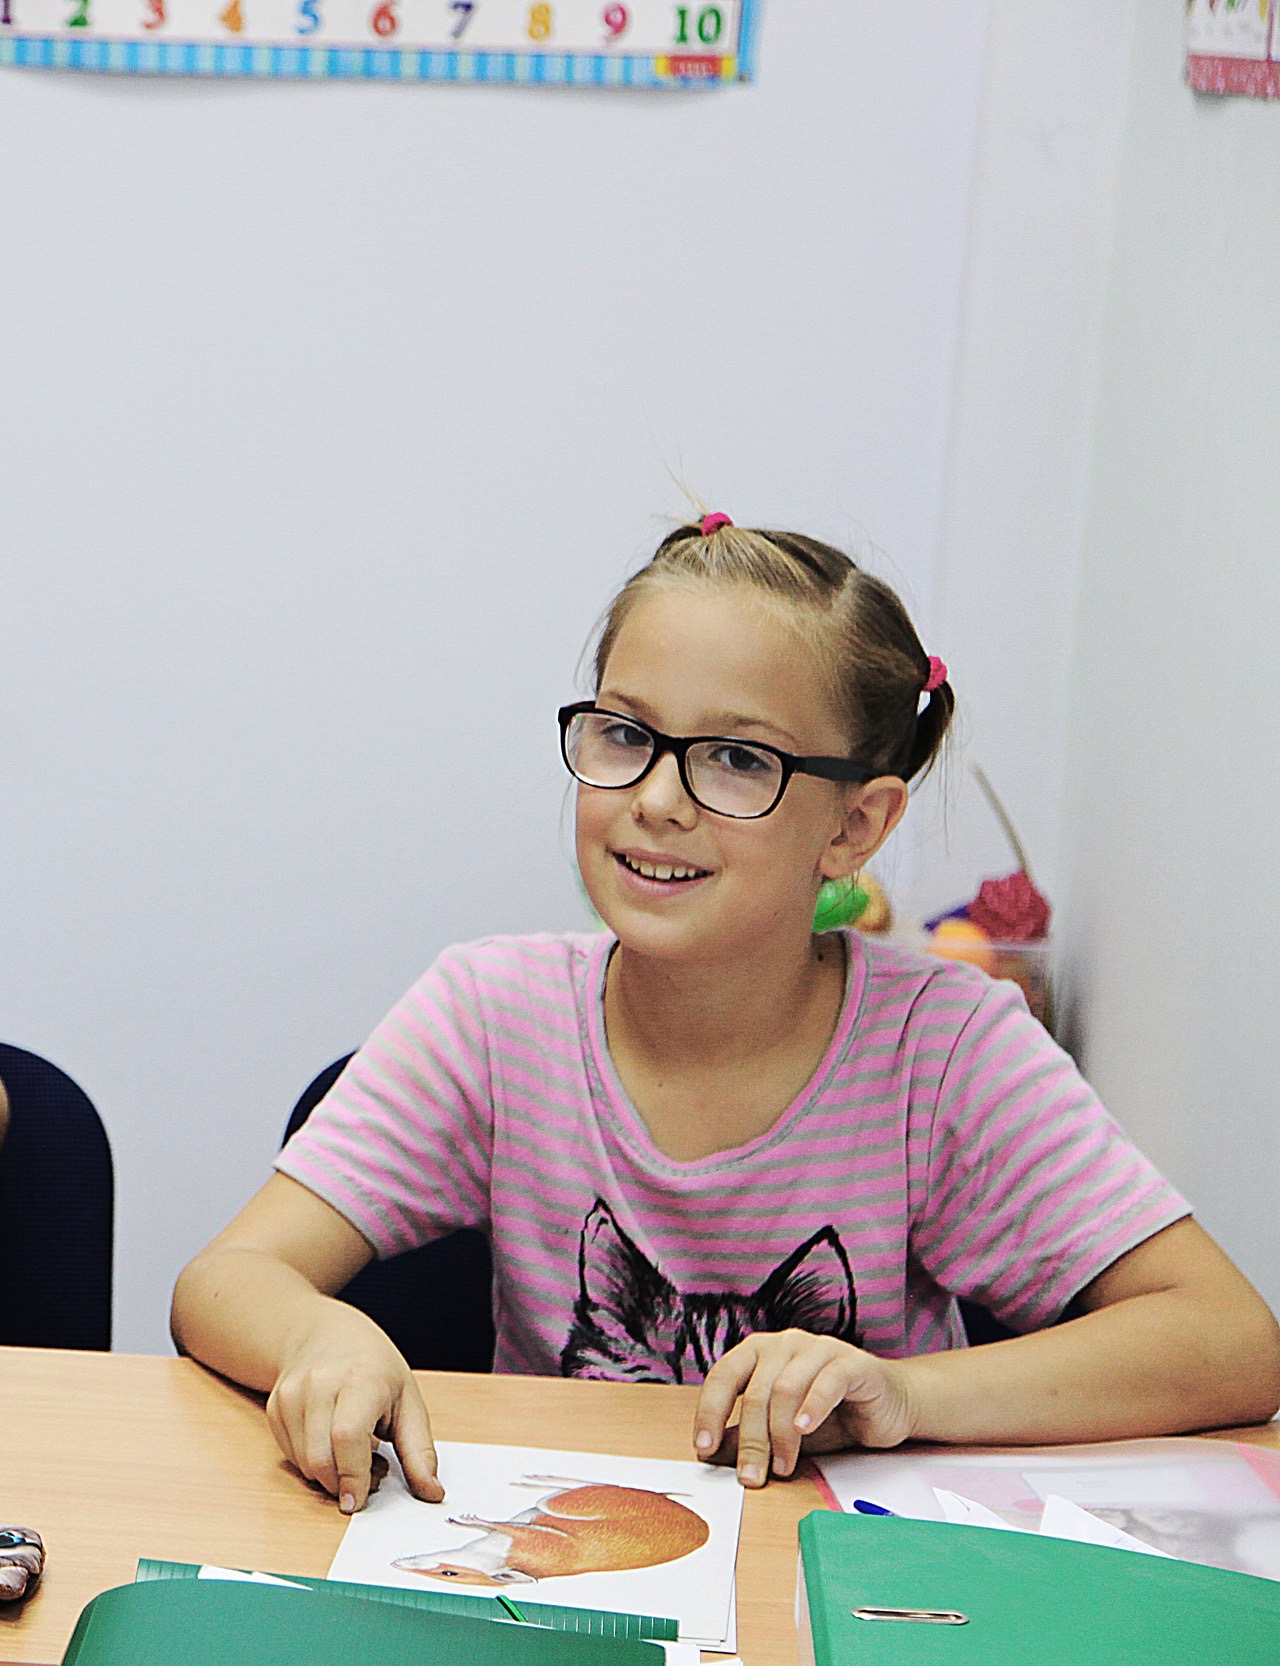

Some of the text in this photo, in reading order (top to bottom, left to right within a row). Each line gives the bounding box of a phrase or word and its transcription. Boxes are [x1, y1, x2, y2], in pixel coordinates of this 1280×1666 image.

[68, 0, 90, 27] 2
[143, 0, 166, 30] 3
[219, 0, 245, 32] 4
[295, 0, 320, 34] 5
[373, 0, 397, 36] 6
[449, 2, 474, 39] 7
[528, 3, 552, 40] 8
[604, 6, 628, 43] 9
[673, 7, 722, 44] 10
